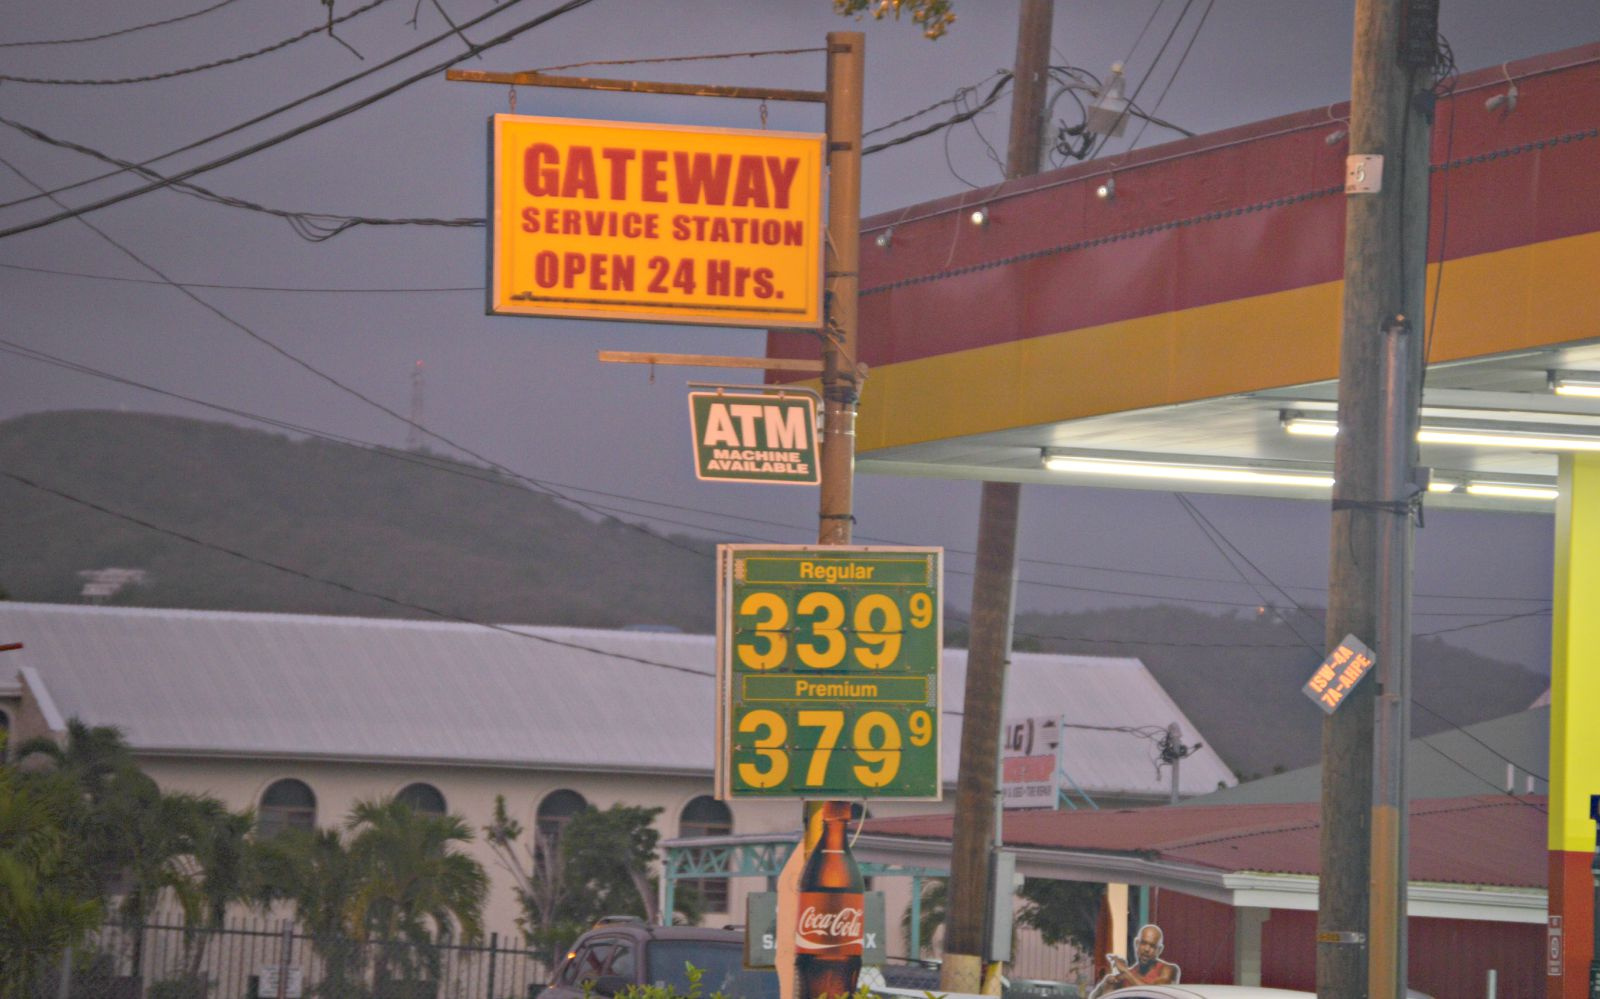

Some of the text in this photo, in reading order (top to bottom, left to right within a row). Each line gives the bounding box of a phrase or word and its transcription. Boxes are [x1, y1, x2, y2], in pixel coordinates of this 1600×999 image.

[523, 142, 801, 210] GATEWAY
[521, 206, 804, 247] SERVICE STATION
[534, 250, 785, 300] OPEN 24 Hrs.
[703, 403, 808, 449] ATM
[707, 459, 810, 474] AVAILABLE
[713, 449, 802, 463] MACHINE
[800, 561, 875, 583] Regular
[796, 680, 878, 698] Premium
[799, 906, 864, 937] Coca-Cola
